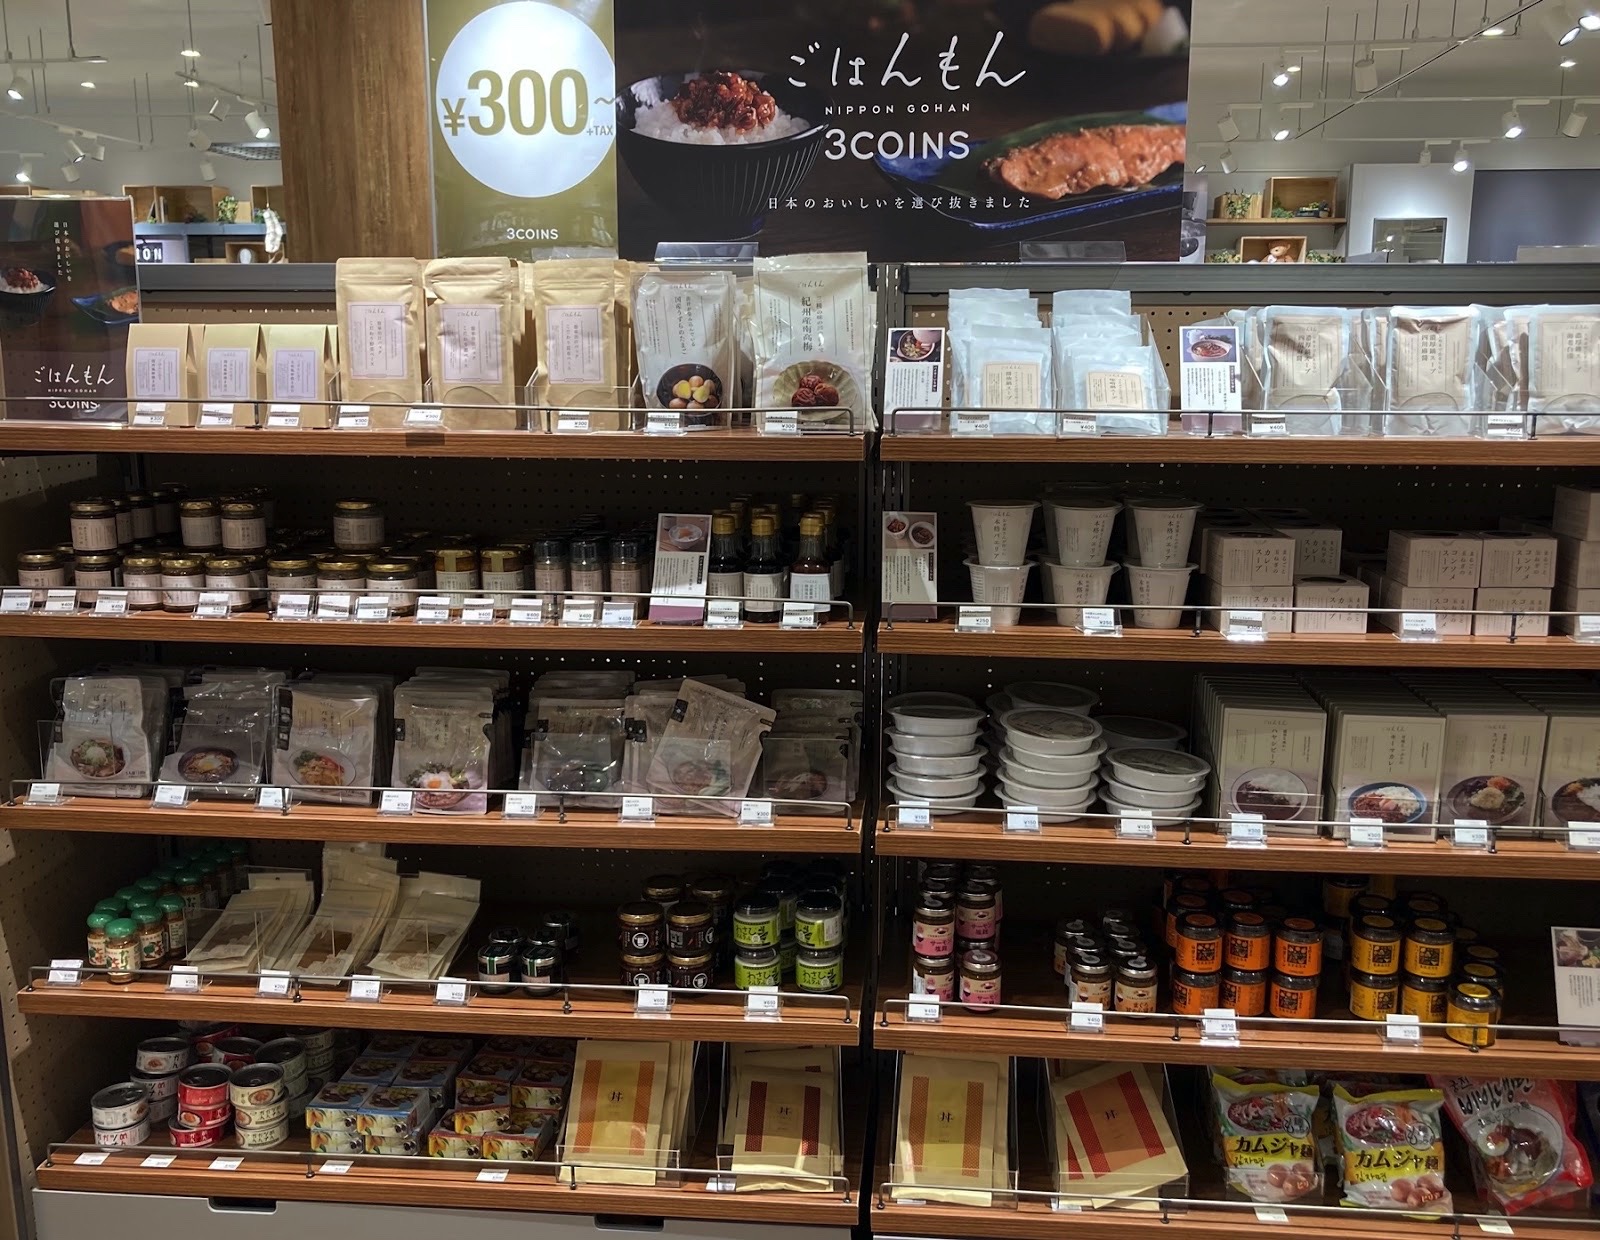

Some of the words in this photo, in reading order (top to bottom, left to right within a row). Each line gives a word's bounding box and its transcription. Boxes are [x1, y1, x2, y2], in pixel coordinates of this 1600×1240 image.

[787, 31, 1027, 90] ごはんもん
[825, 104, 899, 116] NIPPON
[907, 103, 972, 115] GOHAN
[824, 127, 971, 162] 3COINS
[767, 196, 1031, 210] 日本のおいしいを選び抜きました
[507, 227, 559, 240] 3COINS
[674, 296, 687, 355] 国産うずらのたまご
[801, 296, 813, 352] 紀州産南高梅
[34, 363, 114, 386] ごはんもん
[1089, 520, 1100, 560] 本格パエリア
[1164, 520, 1174, 561] 本格パエリア
[1441, 550, 1449, 573] スープ
[1450, 550, 1458, 581] コンソメ
[1515, 550, 1523, 573] スープ
[1523, 550, 1531, 580] コンソメ
[1270, 728, 1278, 766] ハヤシビーフ
[1388, 734, 1396, 773] キーマカレー
[1234, 1136, 1313, 1158] カムジャ麺
[1354, 1150, 1439, 1170] カムジャ麺
